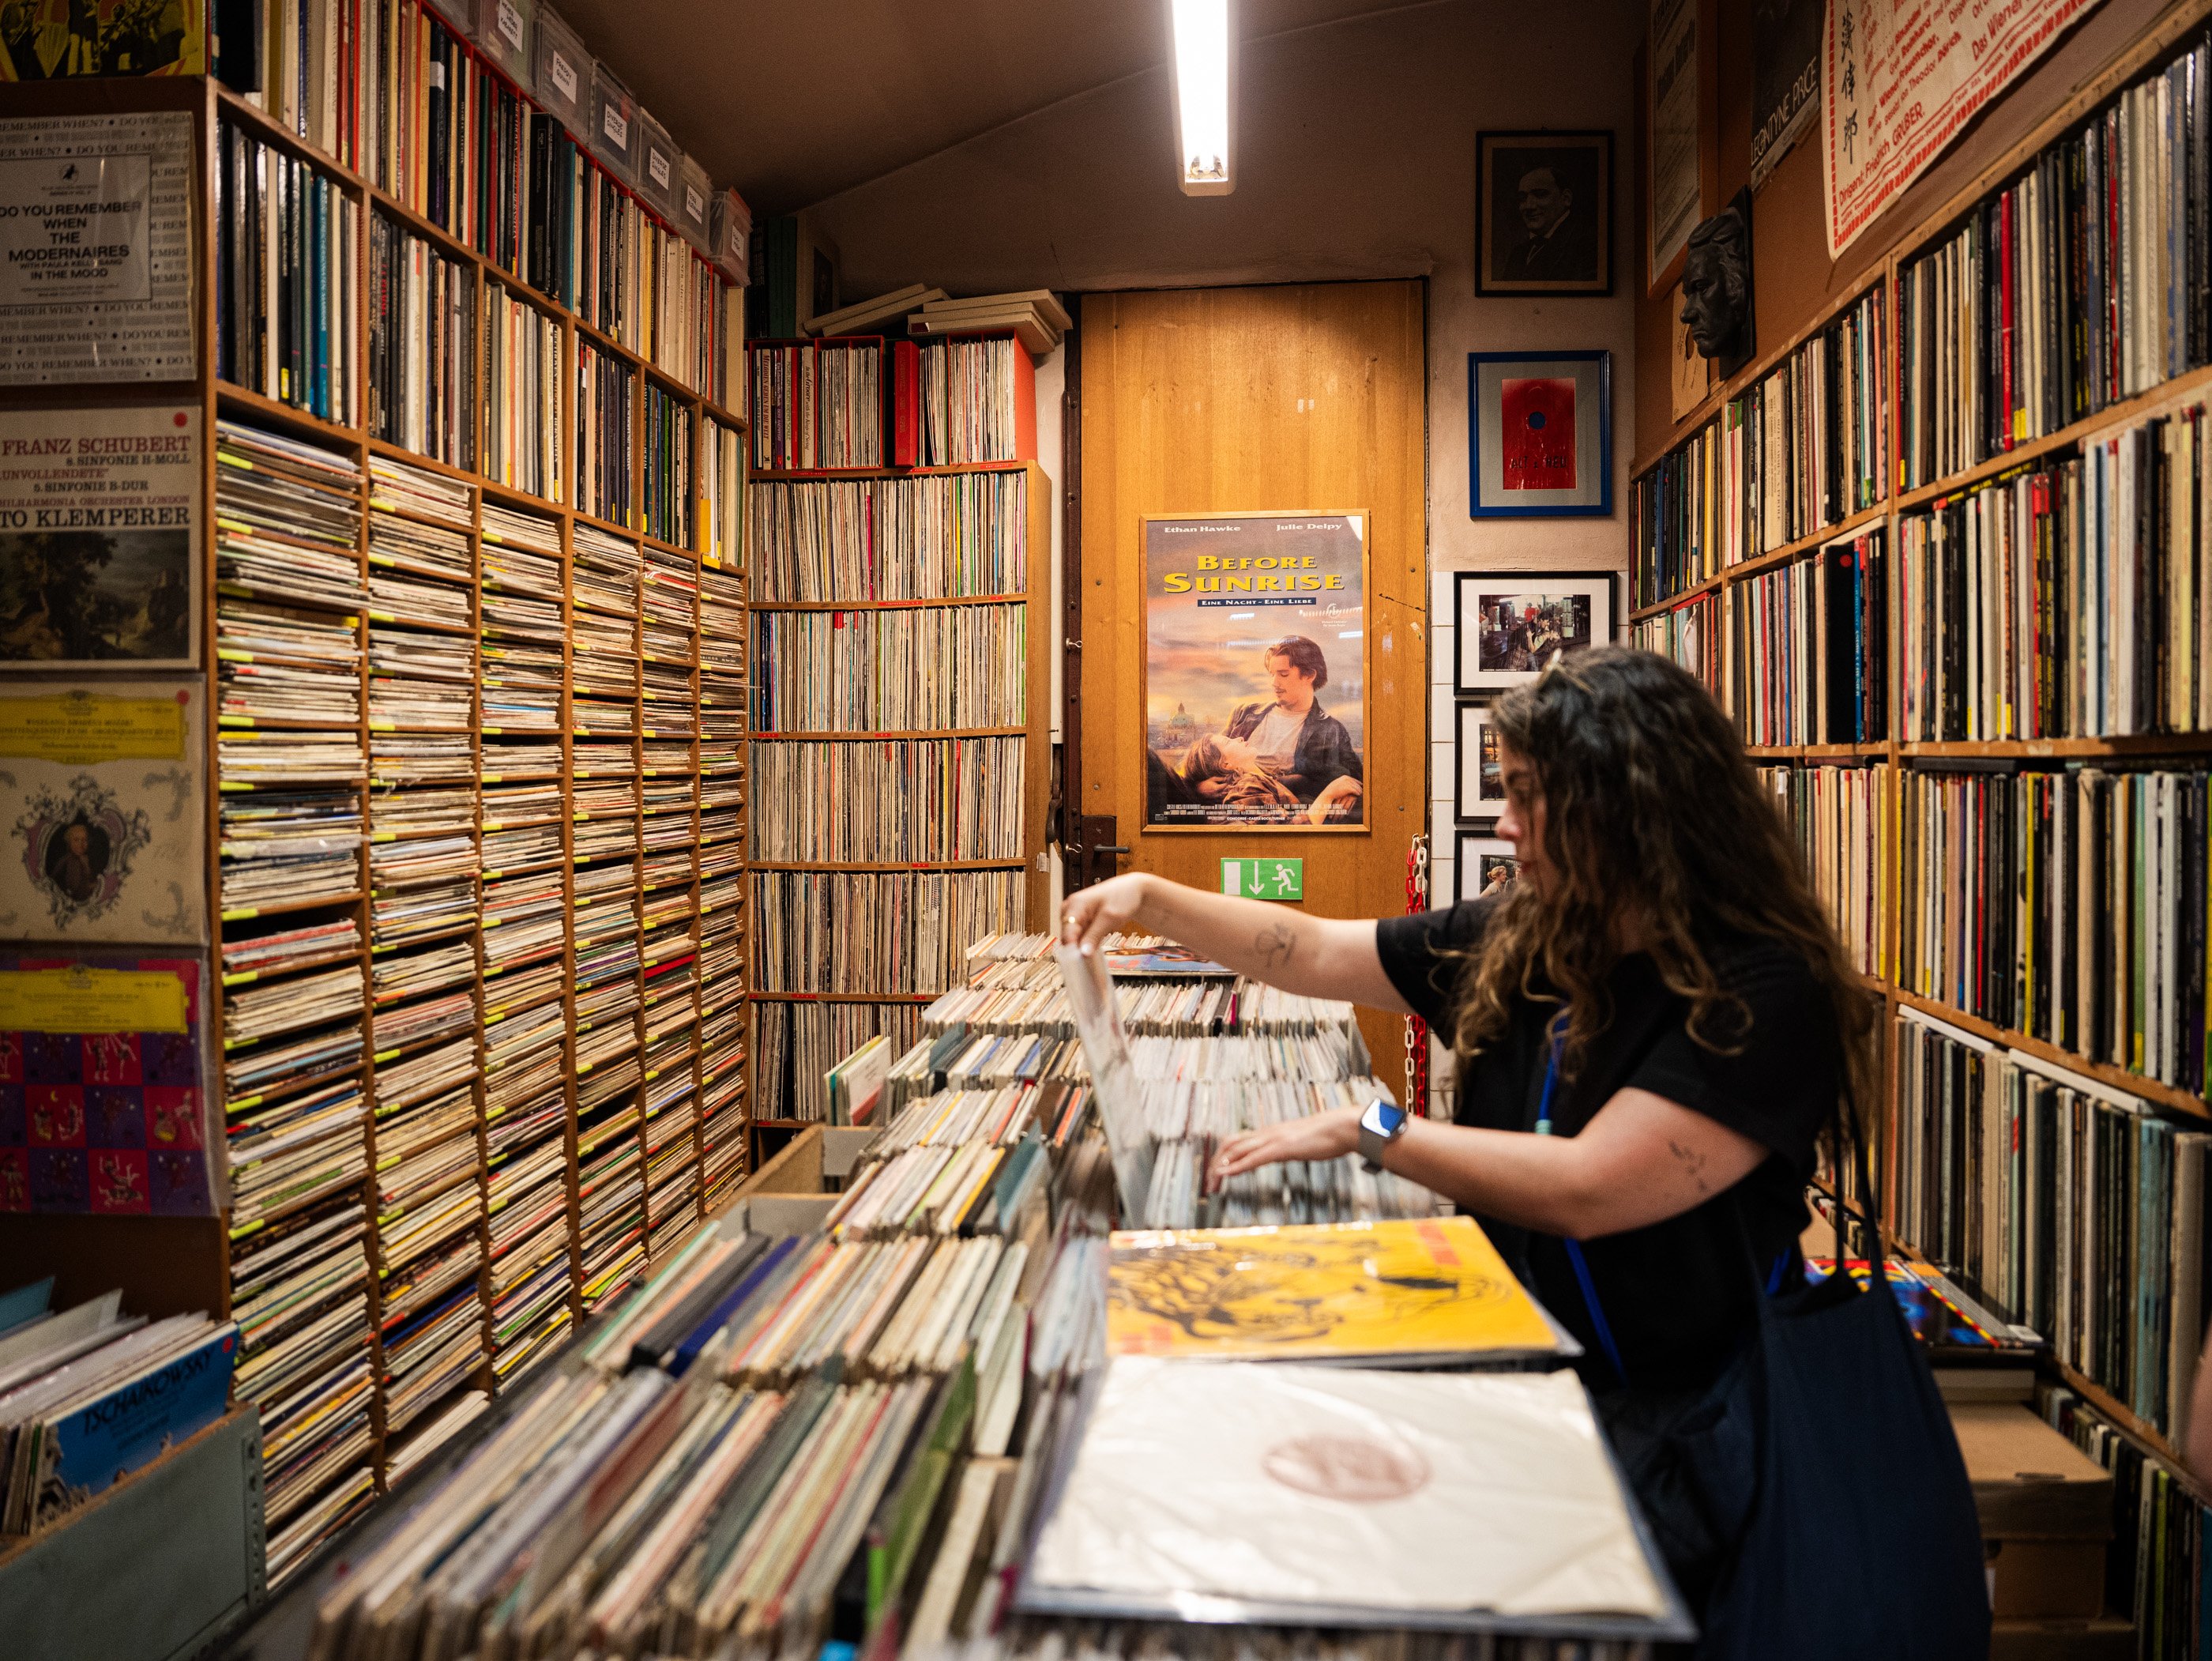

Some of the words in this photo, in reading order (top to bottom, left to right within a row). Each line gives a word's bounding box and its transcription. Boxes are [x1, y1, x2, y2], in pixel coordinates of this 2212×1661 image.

[1793, 55, 1817, 111] PRICE
[607, 111, 623, 130] DIVERSE
[21, 205, 53, 217] YOU
[55, 200, 142, 216] REMEMBER
[43, 217, 88, 230] WHEN
[50, 232, 81, 244] THE
[9, 245, 130, 262] MODERNAIRES
[50, 269, 68, 279] THE
[70, 268, 108, 278] MOOD
[2, 439, 72, 455] FRANZ
[77, 435, 191, 454] SCHUBERT
[77, 455, 139, 465] SINFONIE
[141, 453, 191, 464] H-MOLL
[44, 481, 107, 492] SINFONIE
[109, 480, 149, 491] B-DUR
[36, 507, 190, 527] KLEMPERER
[1276, 523, 1304, 532] Julie
[1307, 522, 1342, 531] Delpy
[1197, 555, 1318, 571] BEFORE
[1164, 572, 1345, 593] SUNRISE
